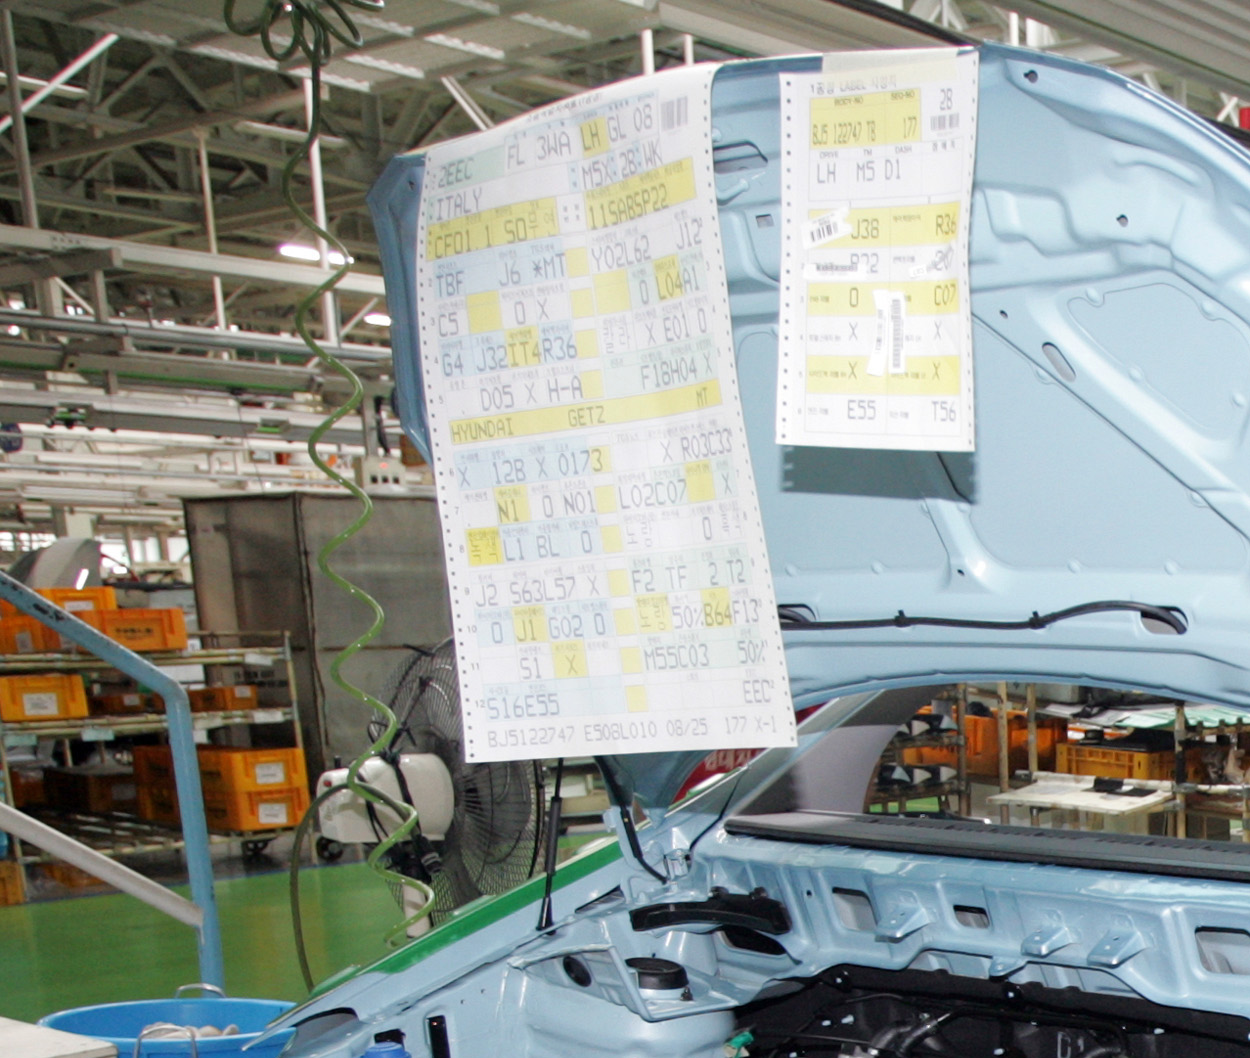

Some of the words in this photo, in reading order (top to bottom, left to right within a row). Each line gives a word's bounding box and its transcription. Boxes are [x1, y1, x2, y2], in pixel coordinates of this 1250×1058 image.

[903, 116, 917, 139] 177
[507, 143, 525, 169] FL
[537, 131, 571, 160] 3WA
[580, 121, 600, 151] LH
[607, 114, 626, 142] GL
[817, 162, 837, 184] LH
[436, 187, 482, 221] ITALY
[935, 213, 957, 237] R36
[499, 260, 521, 287] J6
[438, 311, 459, 338] C5
[536, 297, 550, 320] X
[849, 321, 858, 341] X
[934, 320, 941, 339] X
[645, 321, 656, 346] X
[442, 353, 463, 377] G4
[524, 381, 537, 404] X
[547, 375, 583, 402] H-A
[703, 351, 713, 376] X
[848, 361, 858, 380] X
[932, 361, 941, 380] X
[451, 417, 514, 443] HYUNDAI
[567, 405, 606, 428] GETZ
[695, 387, 708, 409] MT
[457, 466, 471, 488] X
[534, 455, 549, 478] X
[660, 440, 674, 463] X
[497, 498, 520, 523] N1
[721, 471, 733, 495] X
[503, 536, 525, 562] L1
[535, 533, 560, 558] BL
[475, 583, 499, 607] J2
[586, 574, 600, 596] X
[632, 568, 655, 593] F2
[665, 565, 686, 590] TF
[709, 562, 719, 586] 2
[726, 559, 746, 584] T2
[517, 618, 536, 642] J1
[565, 653, 578, 676] X
[742, 679, 770, 704] EEC
[487, 725, 575, 748] BJ5122747
[666, 717, 708, 737] 08/25
[725, 715, 747, 735] 177
